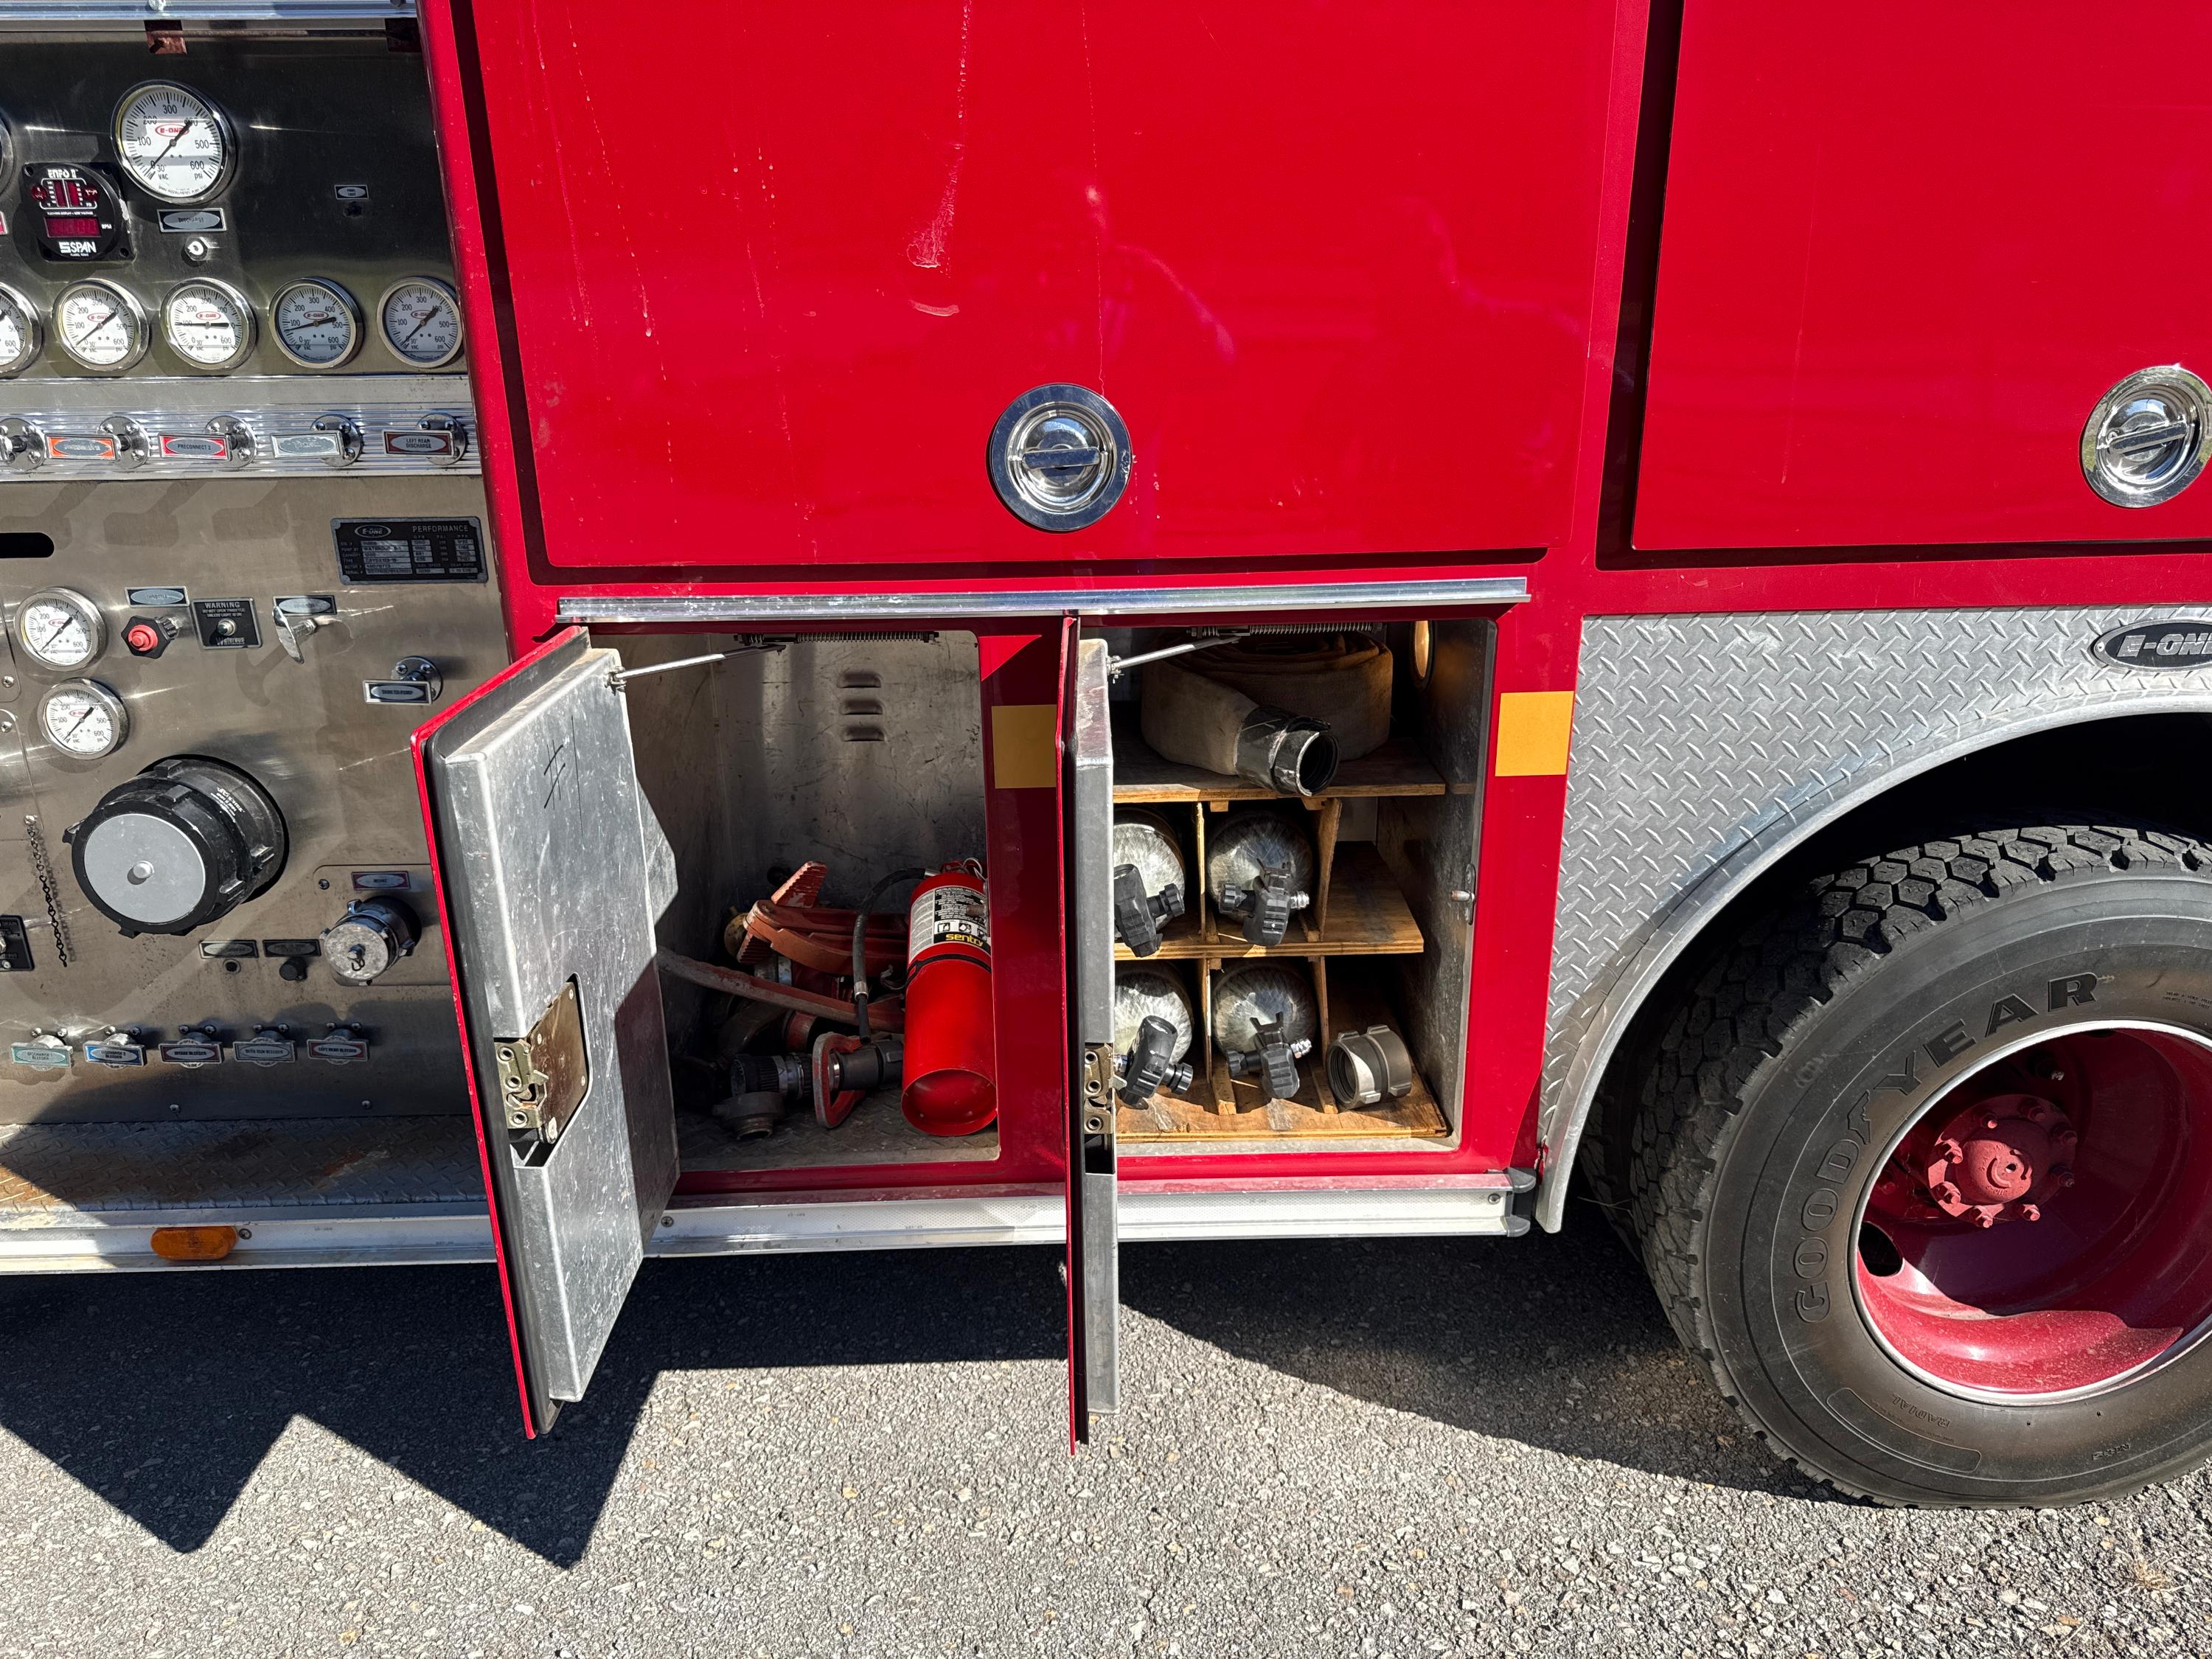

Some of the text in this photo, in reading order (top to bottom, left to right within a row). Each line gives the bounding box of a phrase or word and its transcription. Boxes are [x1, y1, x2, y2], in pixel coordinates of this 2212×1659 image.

[162, 105, 177, 114] 300
[137, 136, 151, 146] 100
[195, 139, 209, 149] 500
[189, 160, 205, 170] 600
[194, 173, 204, 181] psi
[412, 524, 469, 532] PERFORMANCE
[945, 933, 984, 947] sentry
[1793, 972, 2098, 1323] GOODYEAR
[1892, 1392, 1950, 1428] RADIAL
